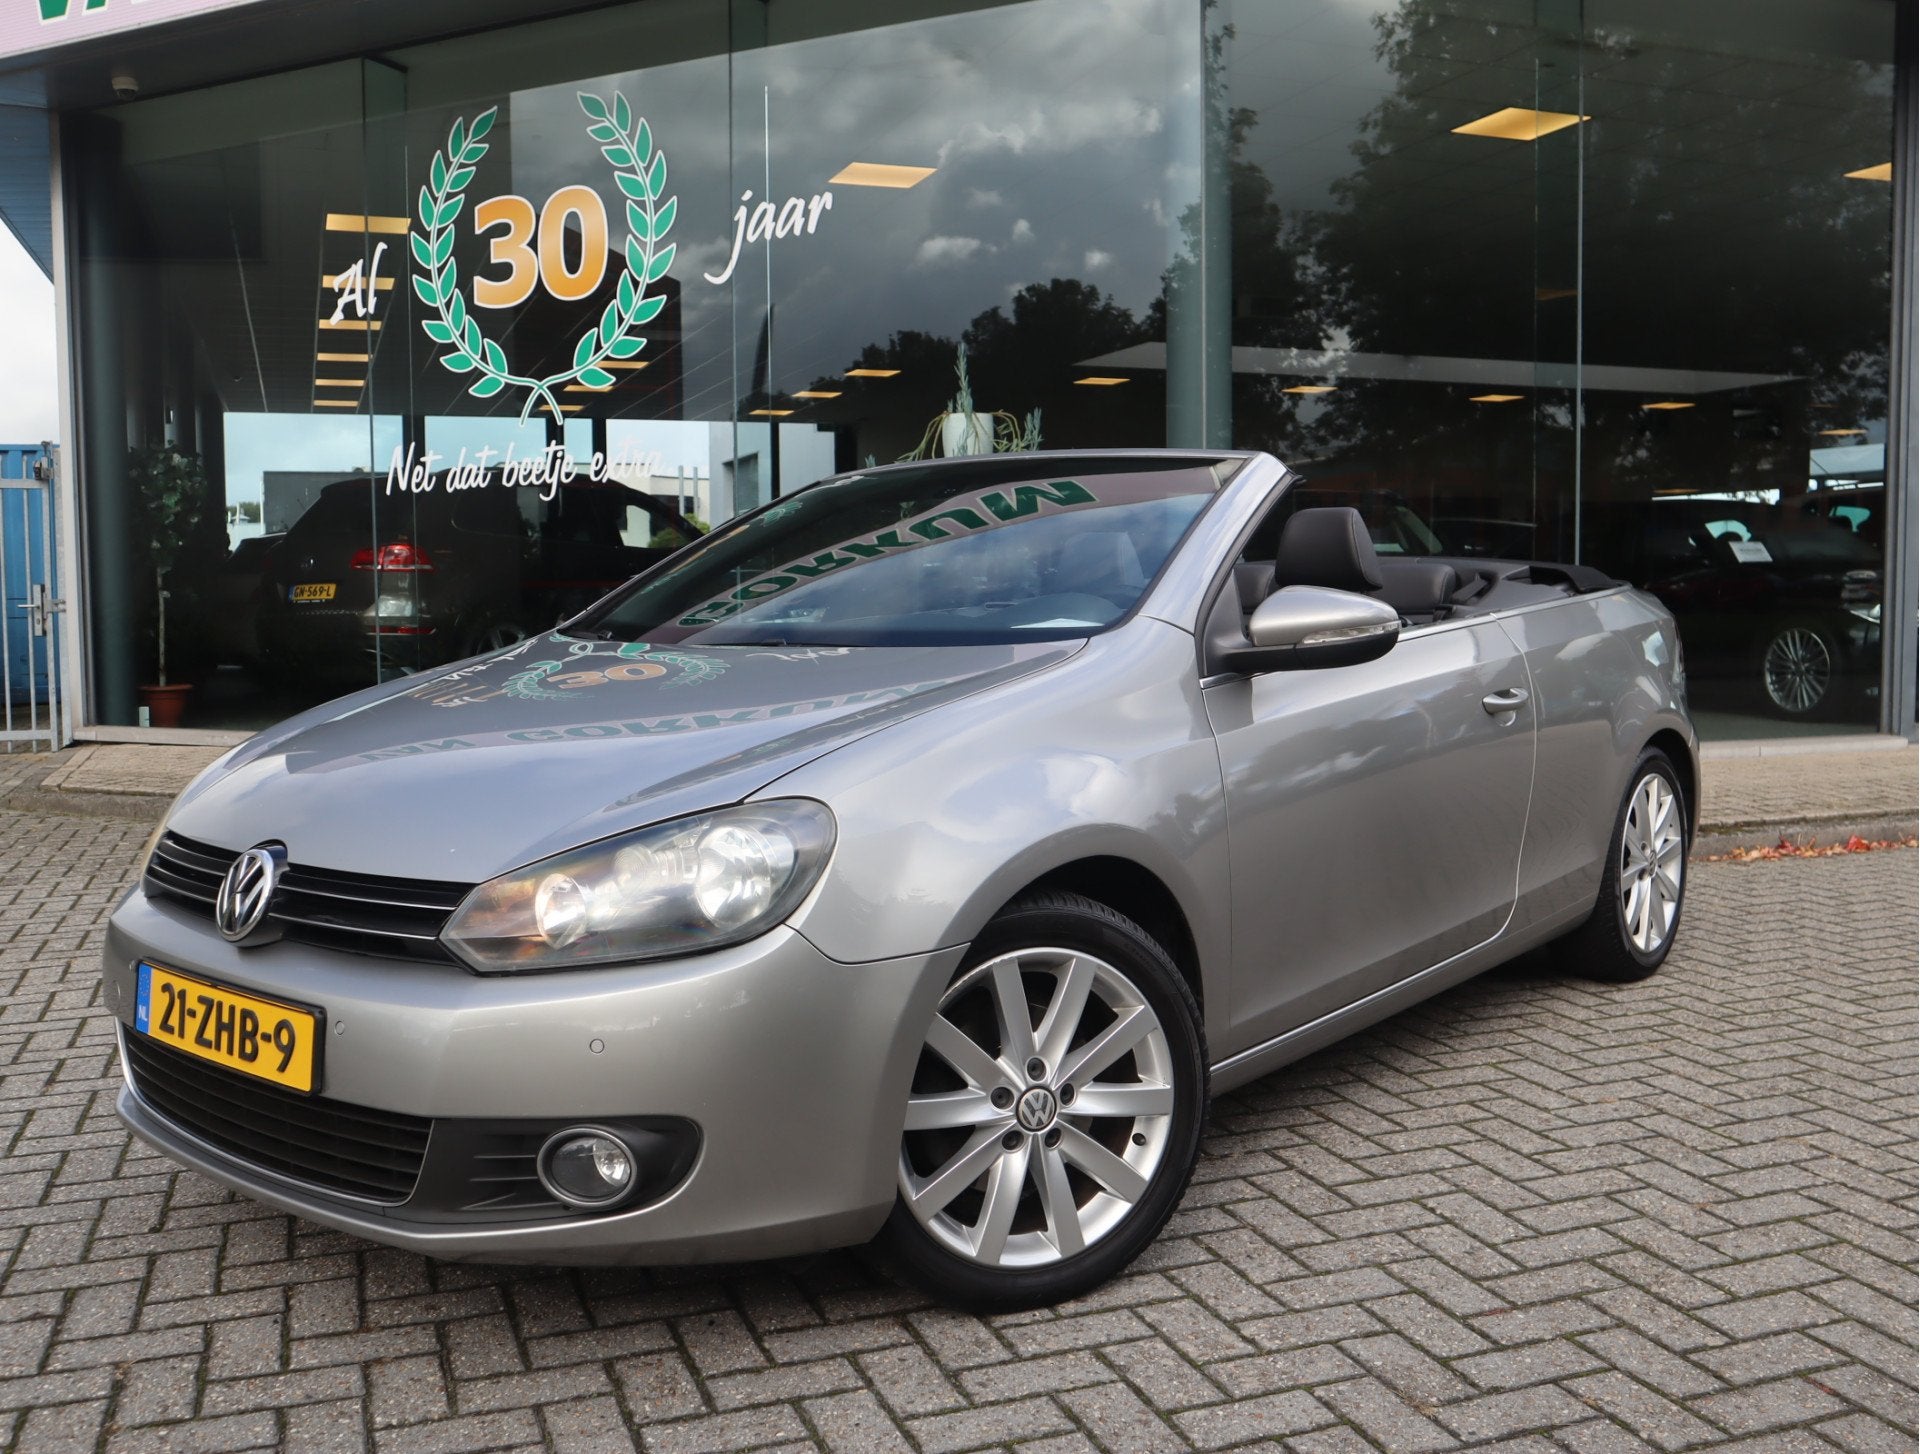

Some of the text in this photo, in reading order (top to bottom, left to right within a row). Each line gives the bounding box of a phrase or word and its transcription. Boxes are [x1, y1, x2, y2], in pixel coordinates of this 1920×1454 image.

[330, 184, 833, 325] Al 30 jaar
[386, 441, 443, 496] Net
[446, 445, 498, 494] dat
[502, 439, 578, 501] beetje
[294, 586, 332, 598] GN-569-L
[138, 1004, 148, 1022] NL
[159, 982, 296, 1074] 21-ZHB-9
[1018, 1088, 1056, 1130] VW
